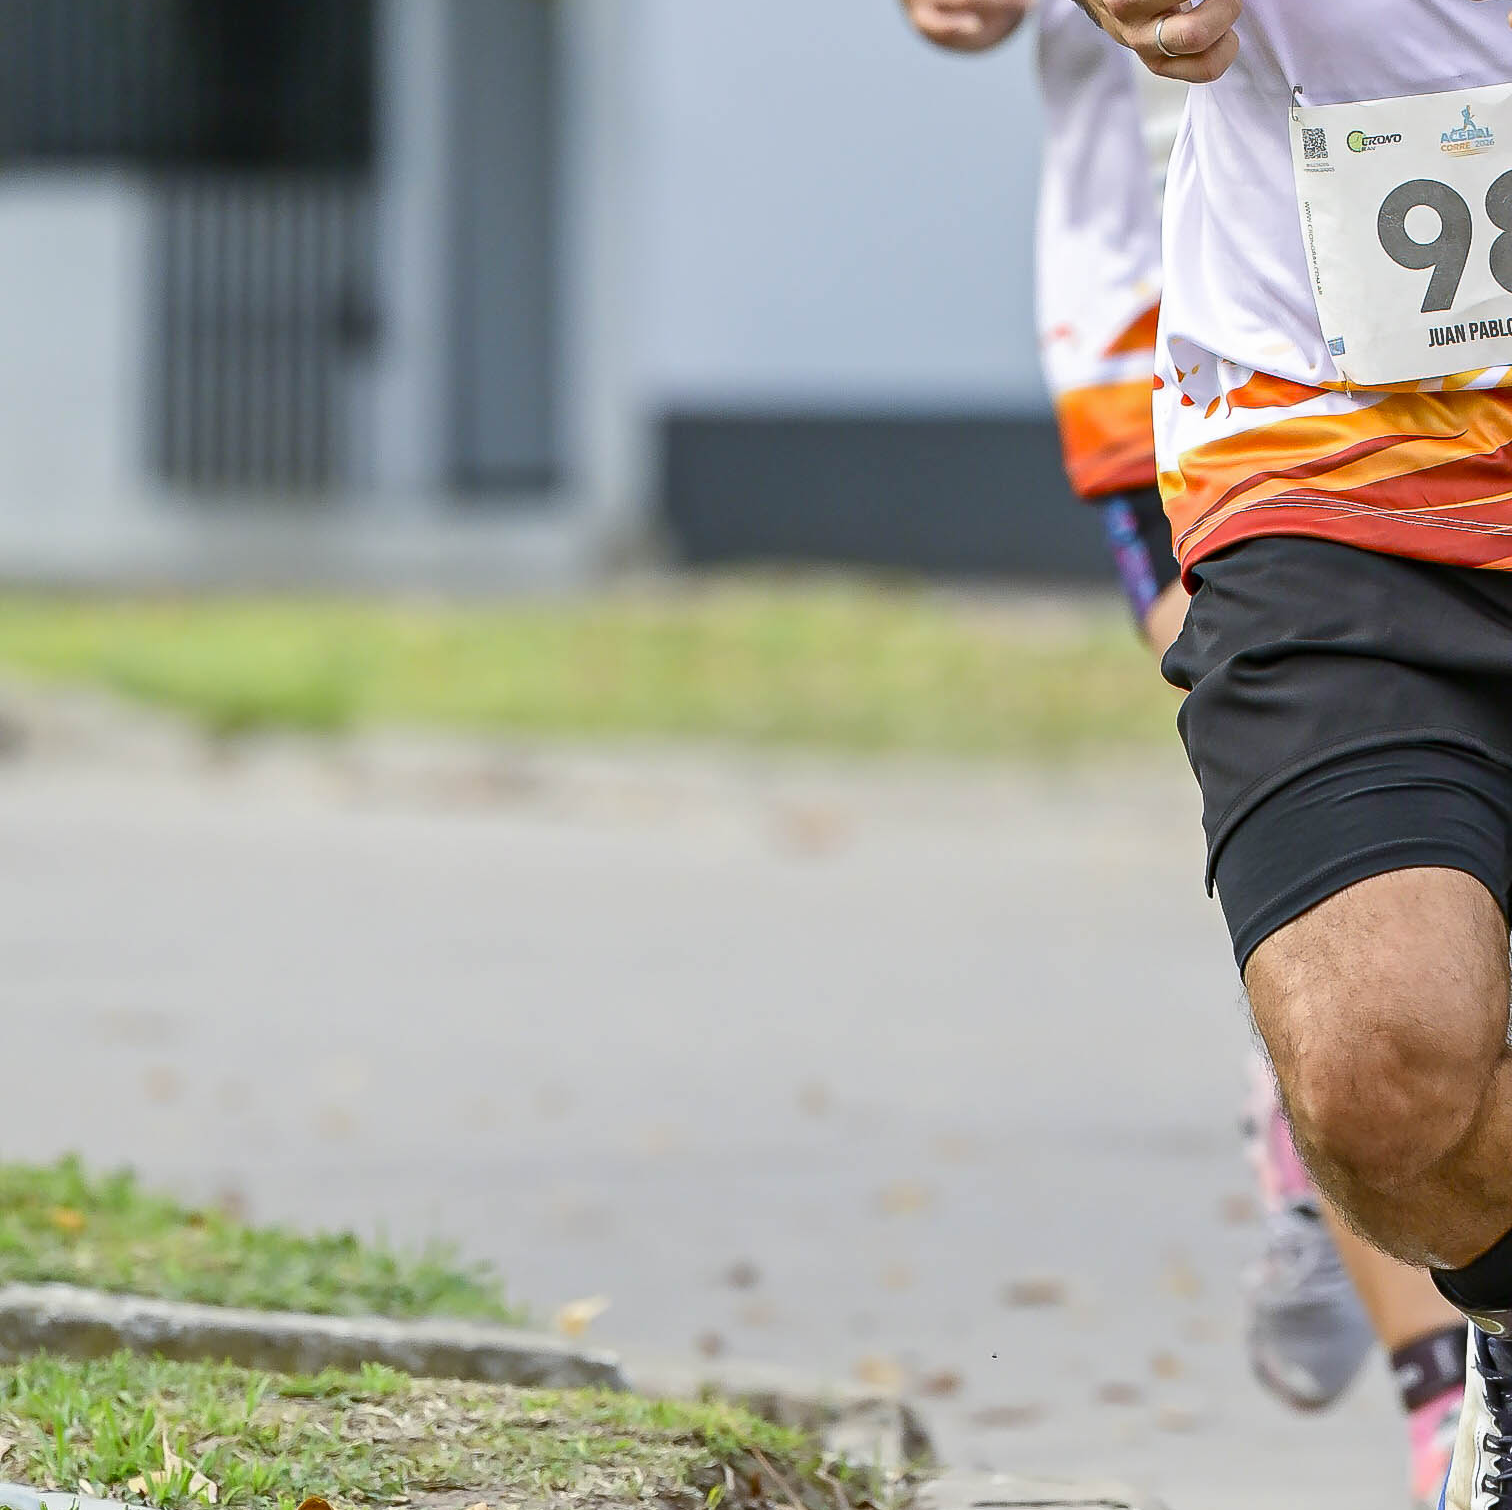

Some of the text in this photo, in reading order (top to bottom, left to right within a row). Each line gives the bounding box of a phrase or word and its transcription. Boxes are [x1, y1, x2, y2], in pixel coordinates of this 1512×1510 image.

[1440, 127, 1494, 143] ACEBAL
[1440, 139, 1495, 152] CORRE 2026
[1428, 323, 1466, 348] JUAN
